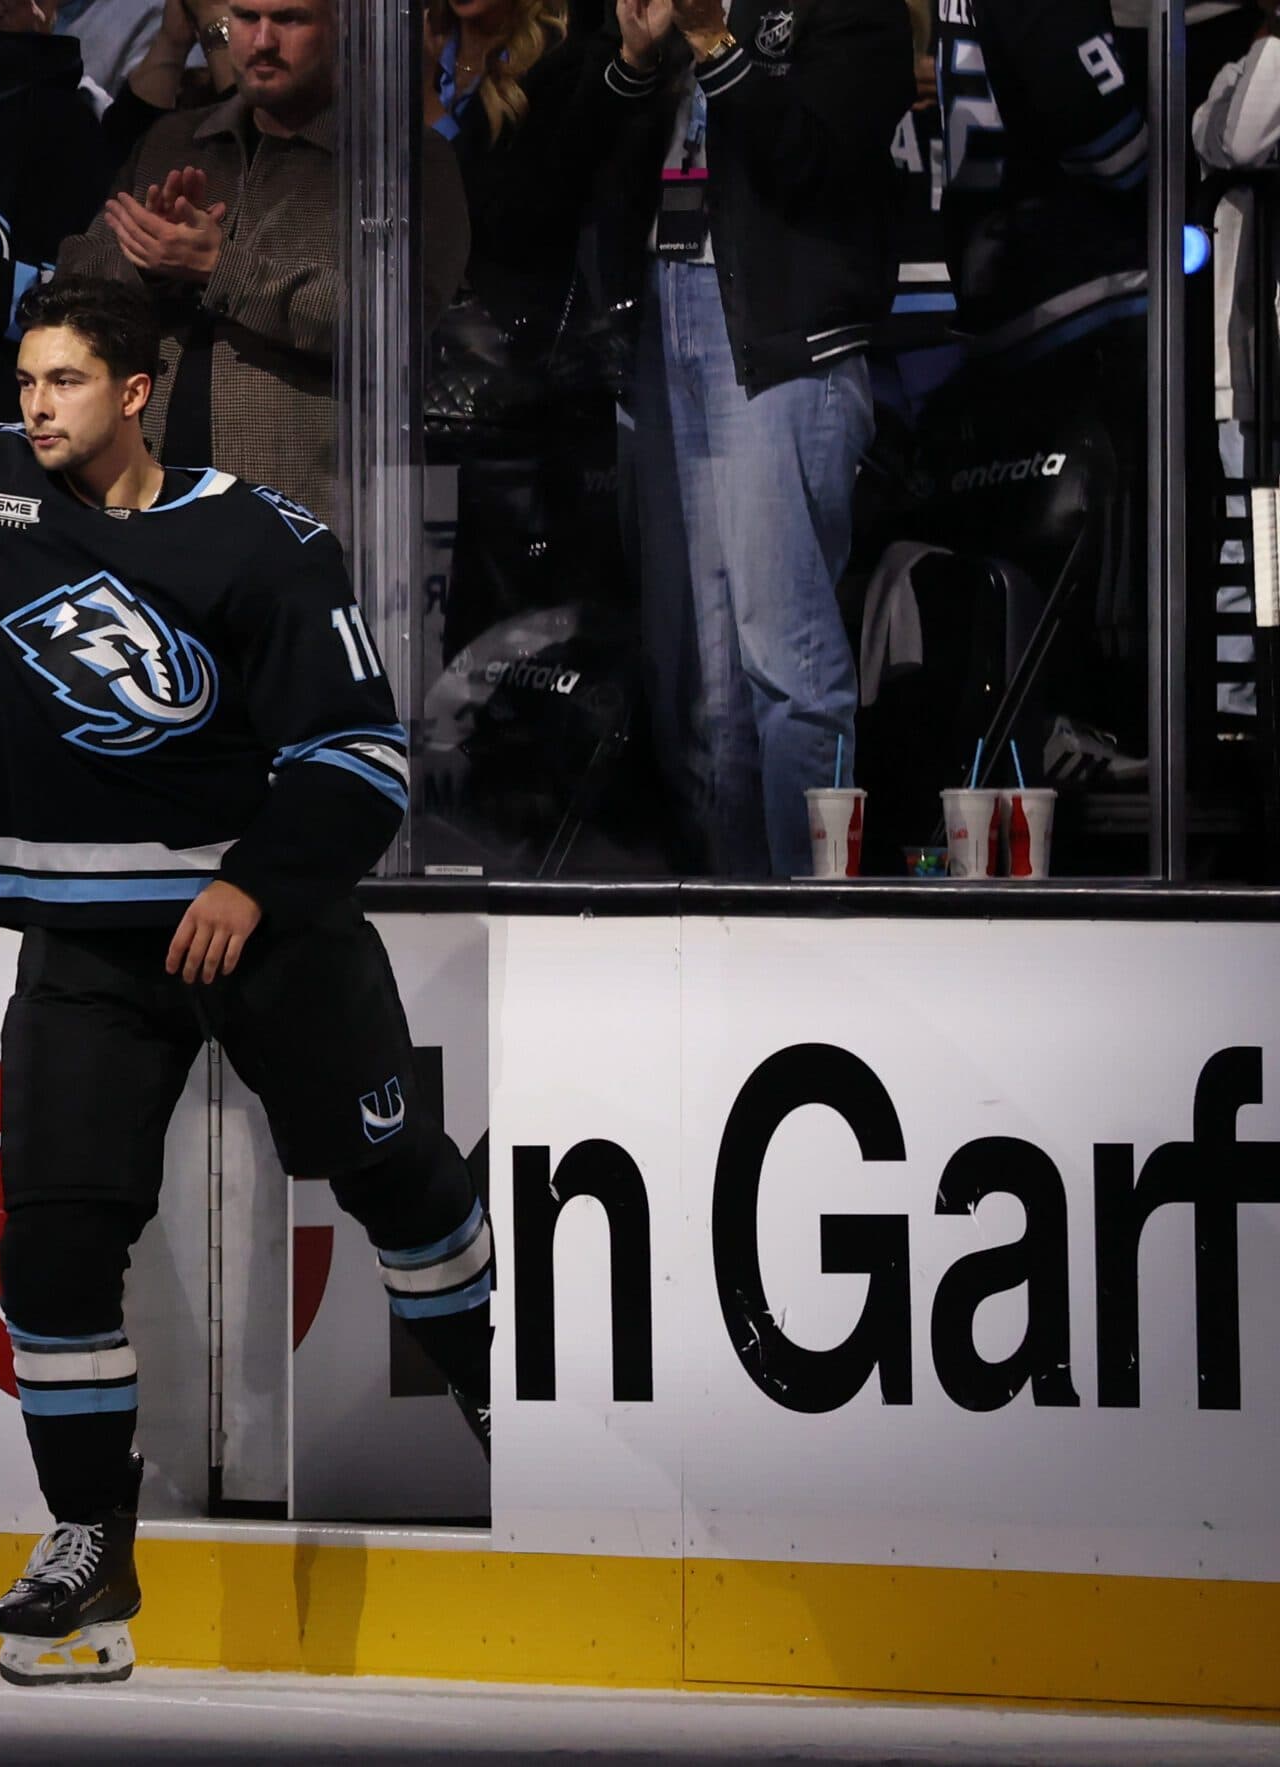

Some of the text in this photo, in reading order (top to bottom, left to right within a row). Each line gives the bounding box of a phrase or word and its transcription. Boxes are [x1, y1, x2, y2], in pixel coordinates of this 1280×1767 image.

[951, 451, 1068, 494] entrata
[330, 604, 383, 682] 11
[484, 657, 581, 696] entrata
[713, 1043, 1280, 1413] Garf
